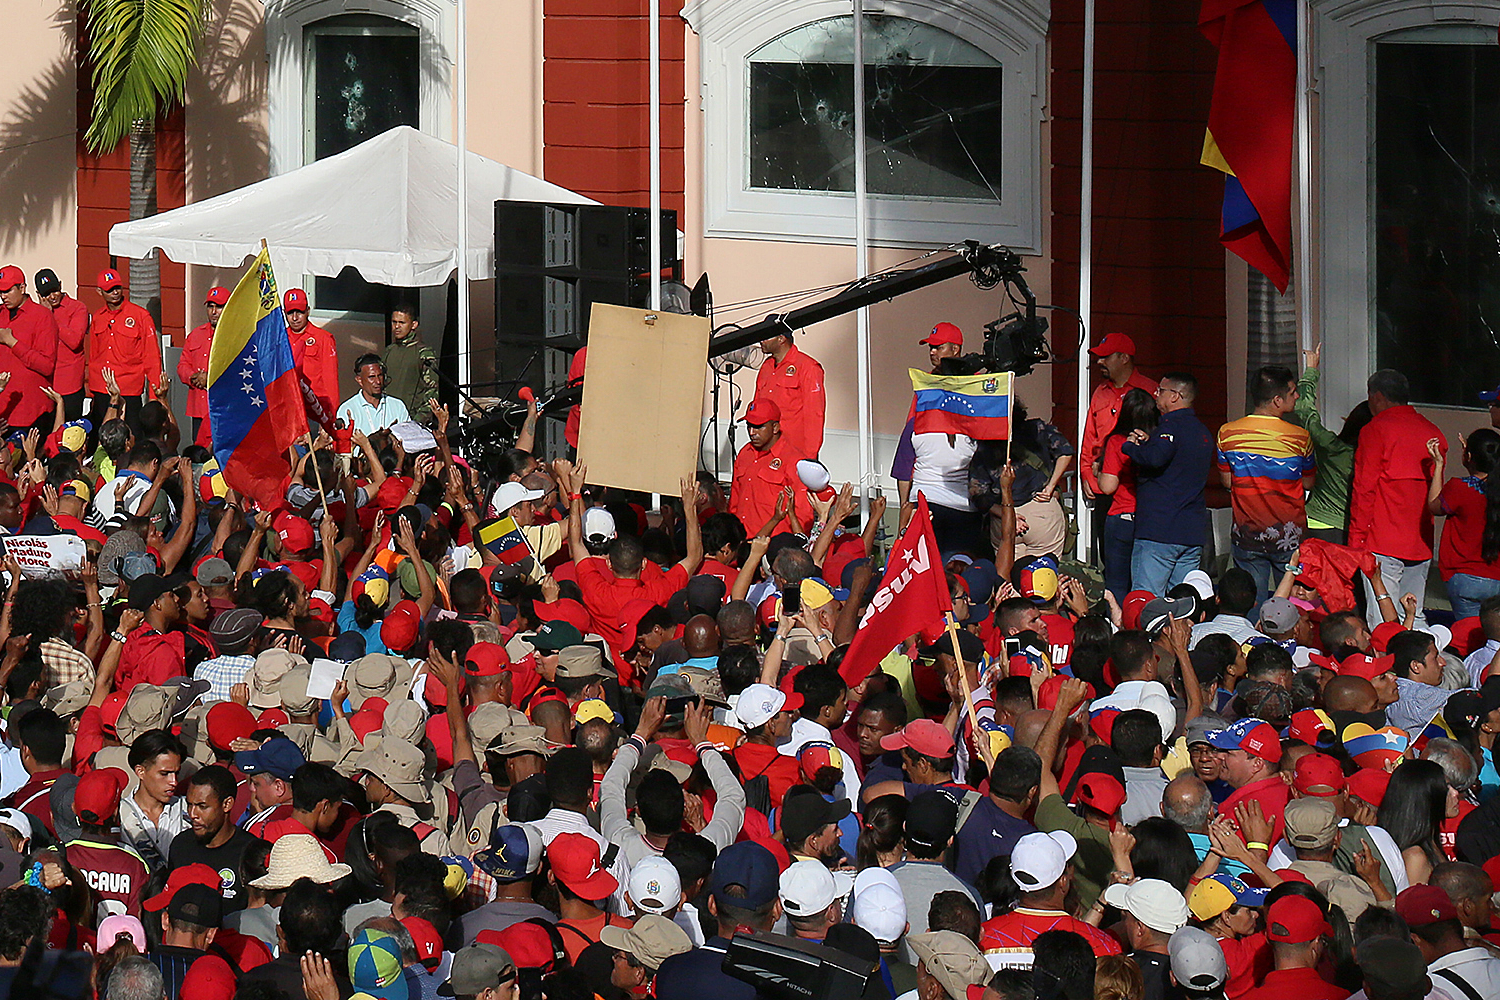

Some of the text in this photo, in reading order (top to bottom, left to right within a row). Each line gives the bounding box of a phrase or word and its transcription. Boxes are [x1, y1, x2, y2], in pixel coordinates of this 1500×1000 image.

[5, 537, 48, 548] Nicolás
[8, 547, 52, 564] Maduro
[16, 556, 51, 568] Moros
[786, 982, 813, 996] HITACHI
